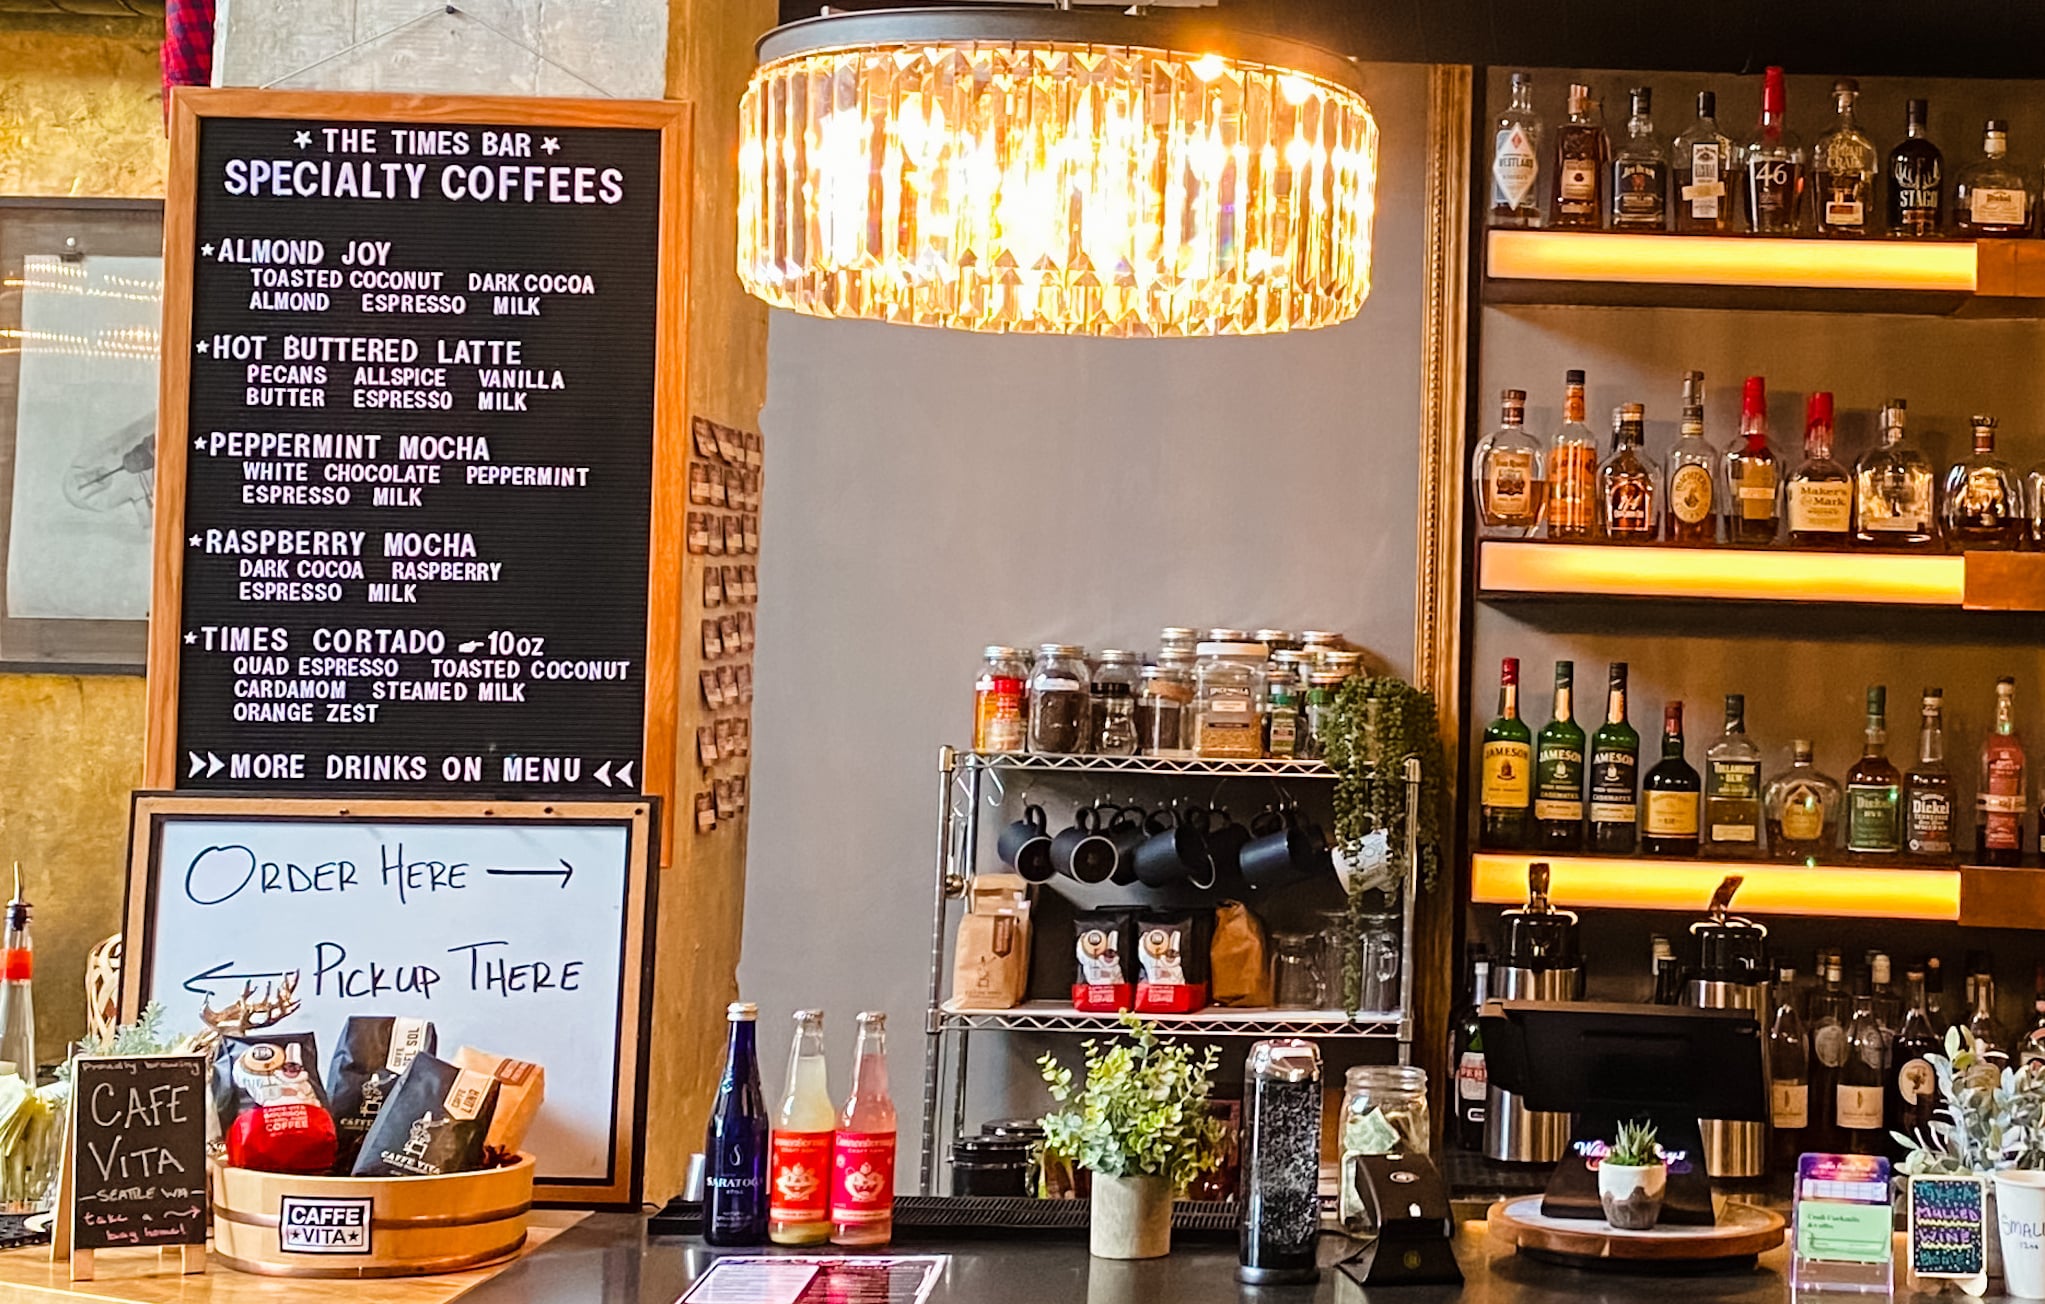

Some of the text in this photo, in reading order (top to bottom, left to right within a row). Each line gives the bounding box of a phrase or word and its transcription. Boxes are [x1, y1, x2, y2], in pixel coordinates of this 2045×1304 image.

[322, 129, 531, 157] THE TIMES BAR
[224, 160, 623, 204] SPECIALTY COFFEES
[1756, 162, 1787, 187] 46
[218, 238, 391, 266] ALMOND JOY
[251, 268, 594, 294] TOASTED COCONUT DARK COCOA
[250, 291, 540, 315] ALMOND ESPRESSO MILK
[214, 335, 521, 364] HOT BUTTERED LATTE
[248, 364, 564, 389] PECANS ALLSPICE VANILLA
[247, 387, 527, 411] BUTTER ESPRESSO MILK
[210, 432, 489, 460] PEPPERMINT MOCHA
[243, 461, 589, 486] WHITE CHOCOLATE PEPPERMINT
[243, 485, 422, 506] ESPRESSO MILK
[1801, 487, 1847, 495] Maker's
[1814, 498, 1845, 506] Mark
[206, 529, 476, 557] RASPBERRY MOCHA
[240, 559, 501, 581] DARK COCOA RASPBERRY
[240, 582, 416, 602] ESPRESSO MILK
[201, 627, 544, 656] TIMES CORTADO 10oz
[234, 656, 630, 680] QUAD ESPRESSO TOASTED COCONUT
[234, 680, 525, 701] CARDAMOM STEAMED MILK
[234, 703, 378, 722] ORANGE ZEST
[1485, 747, 1528, 759] JAMESON
[1539, 750, 1581, 762] JAMESON
[1593, 753, 1634, 766] AMESON
[231, 754, 580, 782] MORE DRINKS ON MENU
[1913, 800, 1950, 814] Dickel
[406, 1027, 420, 1046] SOL
[91, 1082, 189, 1128] CAFE
[266, 1120, 308, 1131] COFFEE
[88, 1134, 184, 1182] VITA
[381, 1150, 416, 1165] CAFFE
[417, 1160, 441, 1175] VITA
[161, 1187, 188, 1199] WA
[706, 1177, 763, 1187] SARATOG
[291, 1206, 360, 1226] CAFFE
[1915, 1207, 1979, 1221] MULLED
[302, 1227, 348, 1245] VITA
[1919, 1229, 1970, 1242] WINE
